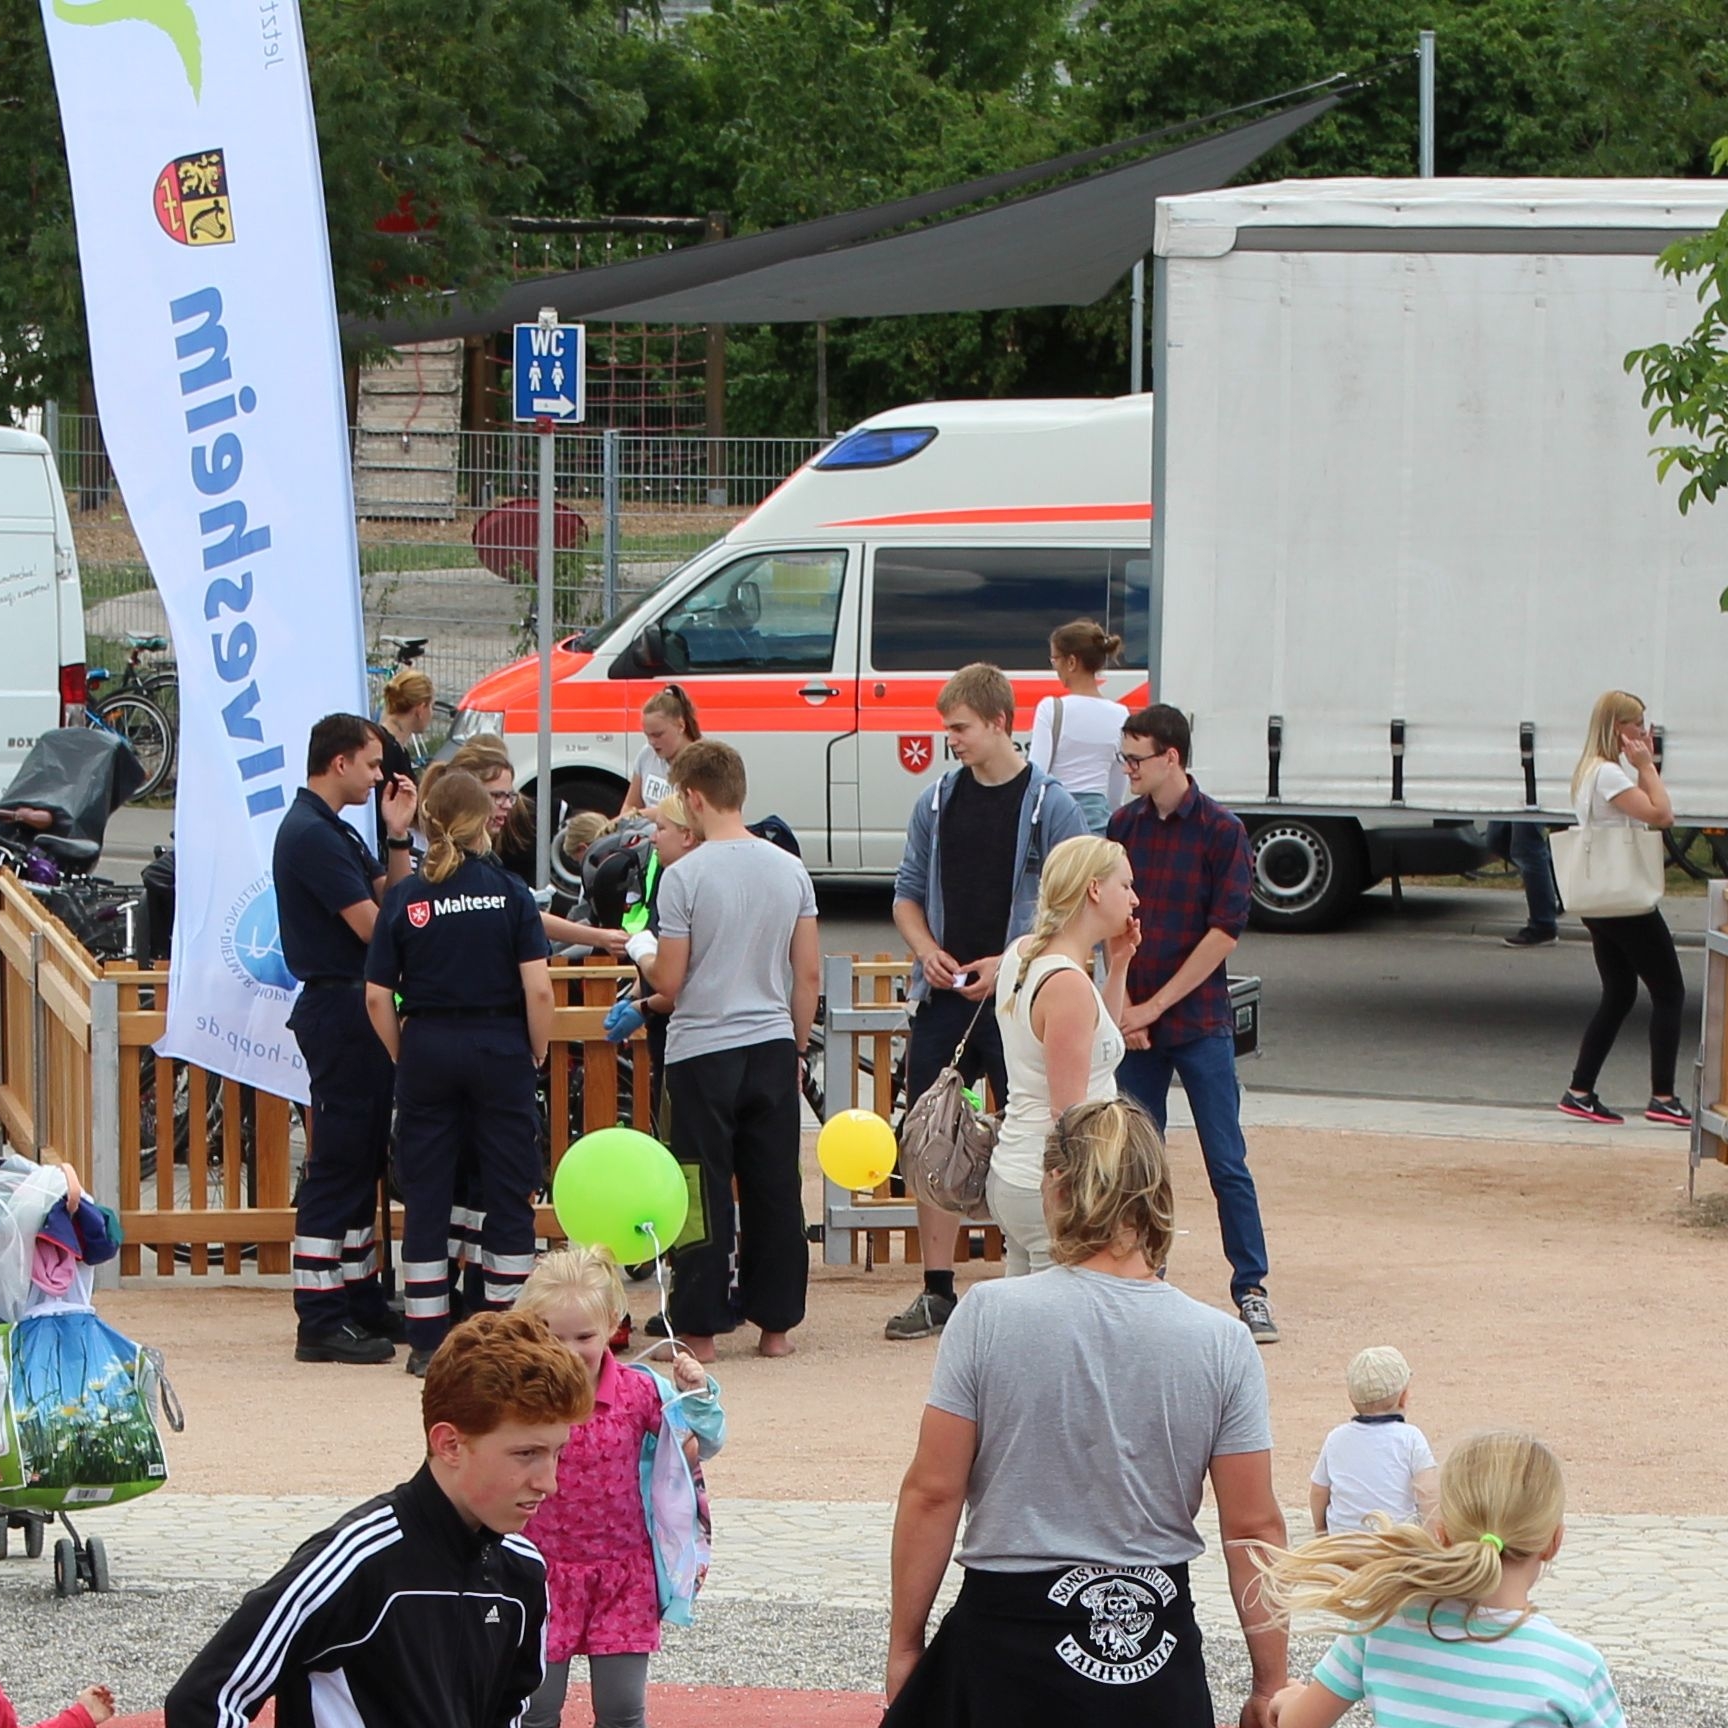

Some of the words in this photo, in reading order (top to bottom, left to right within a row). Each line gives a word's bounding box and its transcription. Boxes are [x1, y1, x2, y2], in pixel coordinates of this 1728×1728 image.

[530, 329, 565, 357] WC
[434, 894, 506, 916] Malteser
[1053, 1567, 1090, 1601] SONS
[1061, 1638, 1176, 1682] CALIFORNIA
